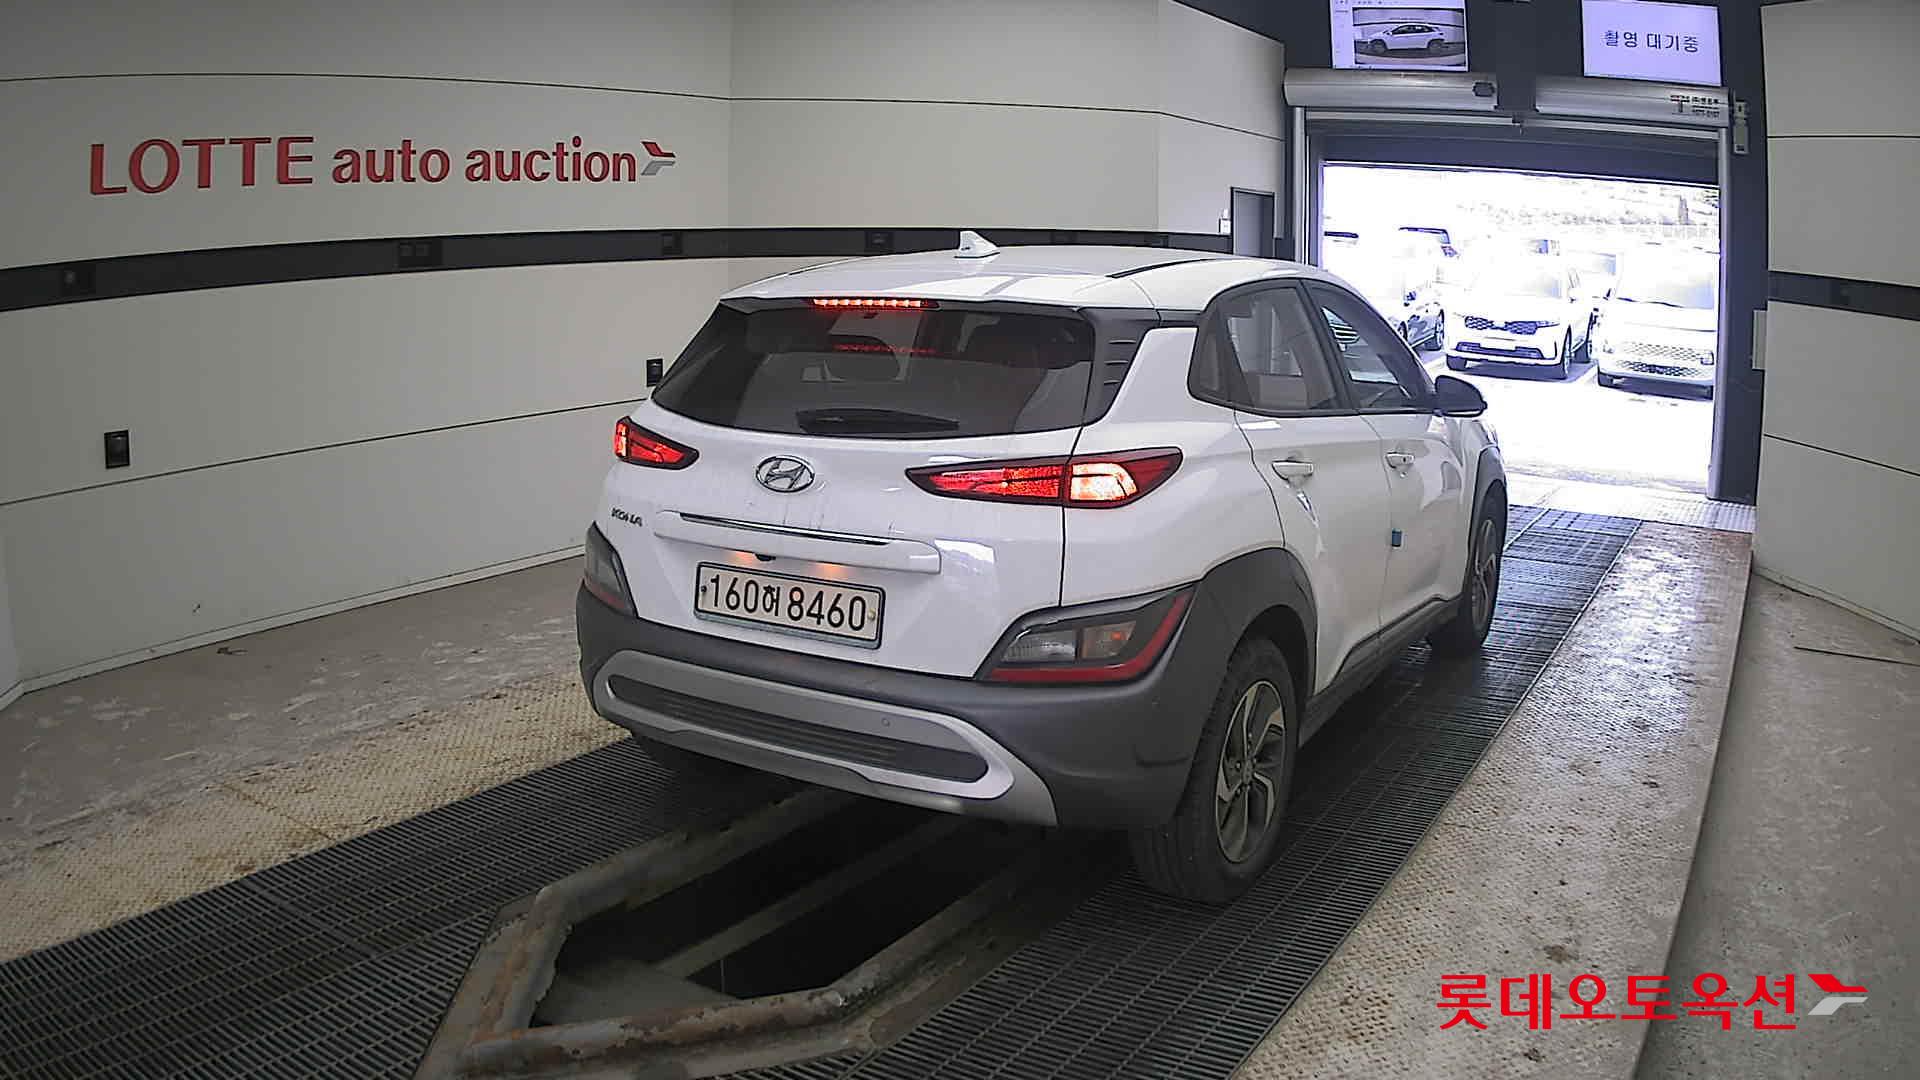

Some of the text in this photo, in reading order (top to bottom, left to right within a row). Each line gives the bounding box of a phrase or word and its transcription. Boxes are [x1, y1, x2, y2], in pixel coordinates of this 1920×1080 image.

[1646, 33, 1698, 53] 대기중
[89, 135, 637, 195] LOTTE auto auction
